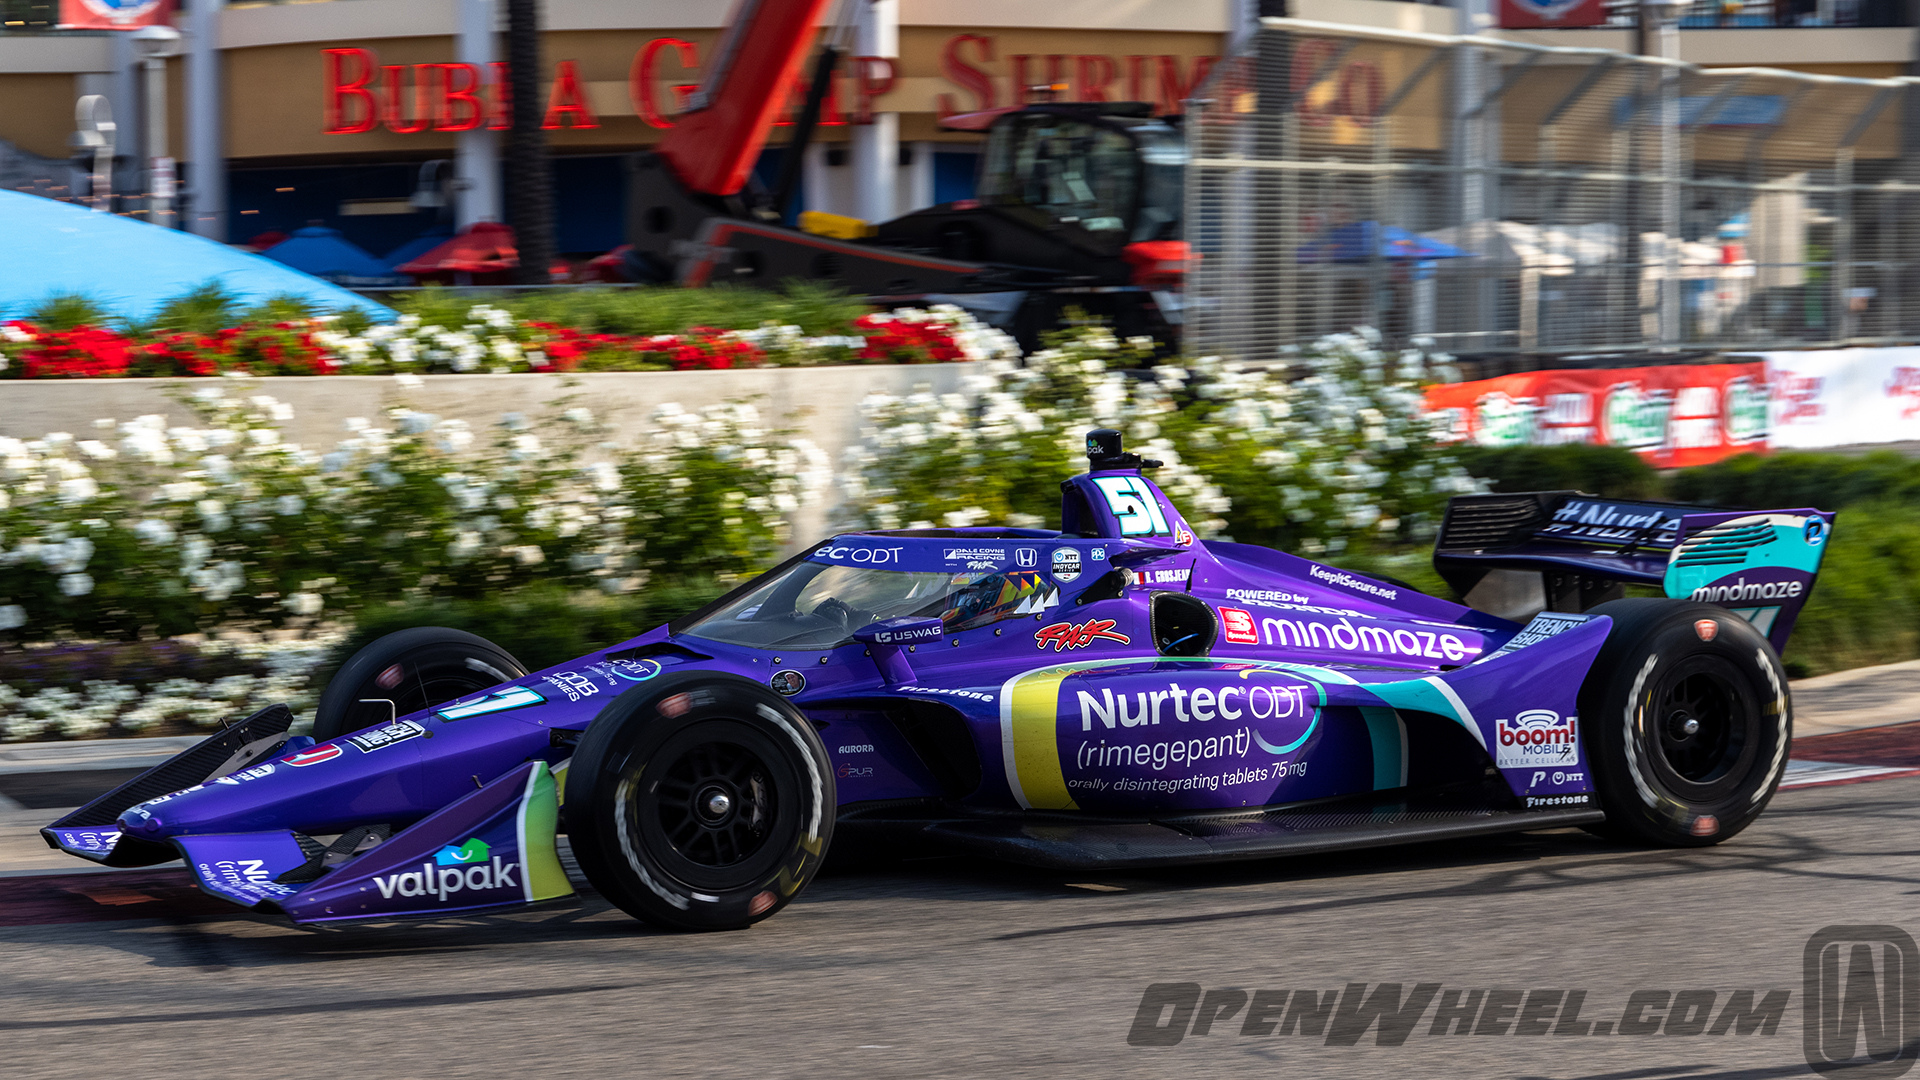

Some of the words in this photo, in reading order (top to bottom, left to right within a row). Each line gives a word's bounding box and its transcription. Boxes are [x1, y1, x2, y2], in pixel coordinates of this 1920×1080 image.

[1092, 476, 1172, 536] 51
[851, 547, 903, 564] ODT
[1226, 588, 1292, 602] POWERED
[1293, 593, 1309, 604] by
[1691, 577, 1803, 602] mindmaze
[1262, 617, 1466, 661] mindmaze
[896, 685, 994, 703] Firestone
[1076, 683, 1243, 732] Nurtec
[1249, 685, 1309, 719] ODT
[1499, 720, 1575, 747] boom!
[838, 744, 875, 754] AURORA
[1077, 726, 1251, 770] (rimegepant)
[1499, 757, 1530, 766] BETTER
[1068, 778, 1109, 792] orally
[1113, 772, 1220, 793] disintegrating
[1222, 765, 1269, 786] tablets
[1271, 760, 1288, 778] 75
[1289, 760, 1308, 777] mg
[1566, 773, 1584, 782] NTT
[1525, 795, 1589, 808] Firestone
[371, 856, 518, 901] valpak
